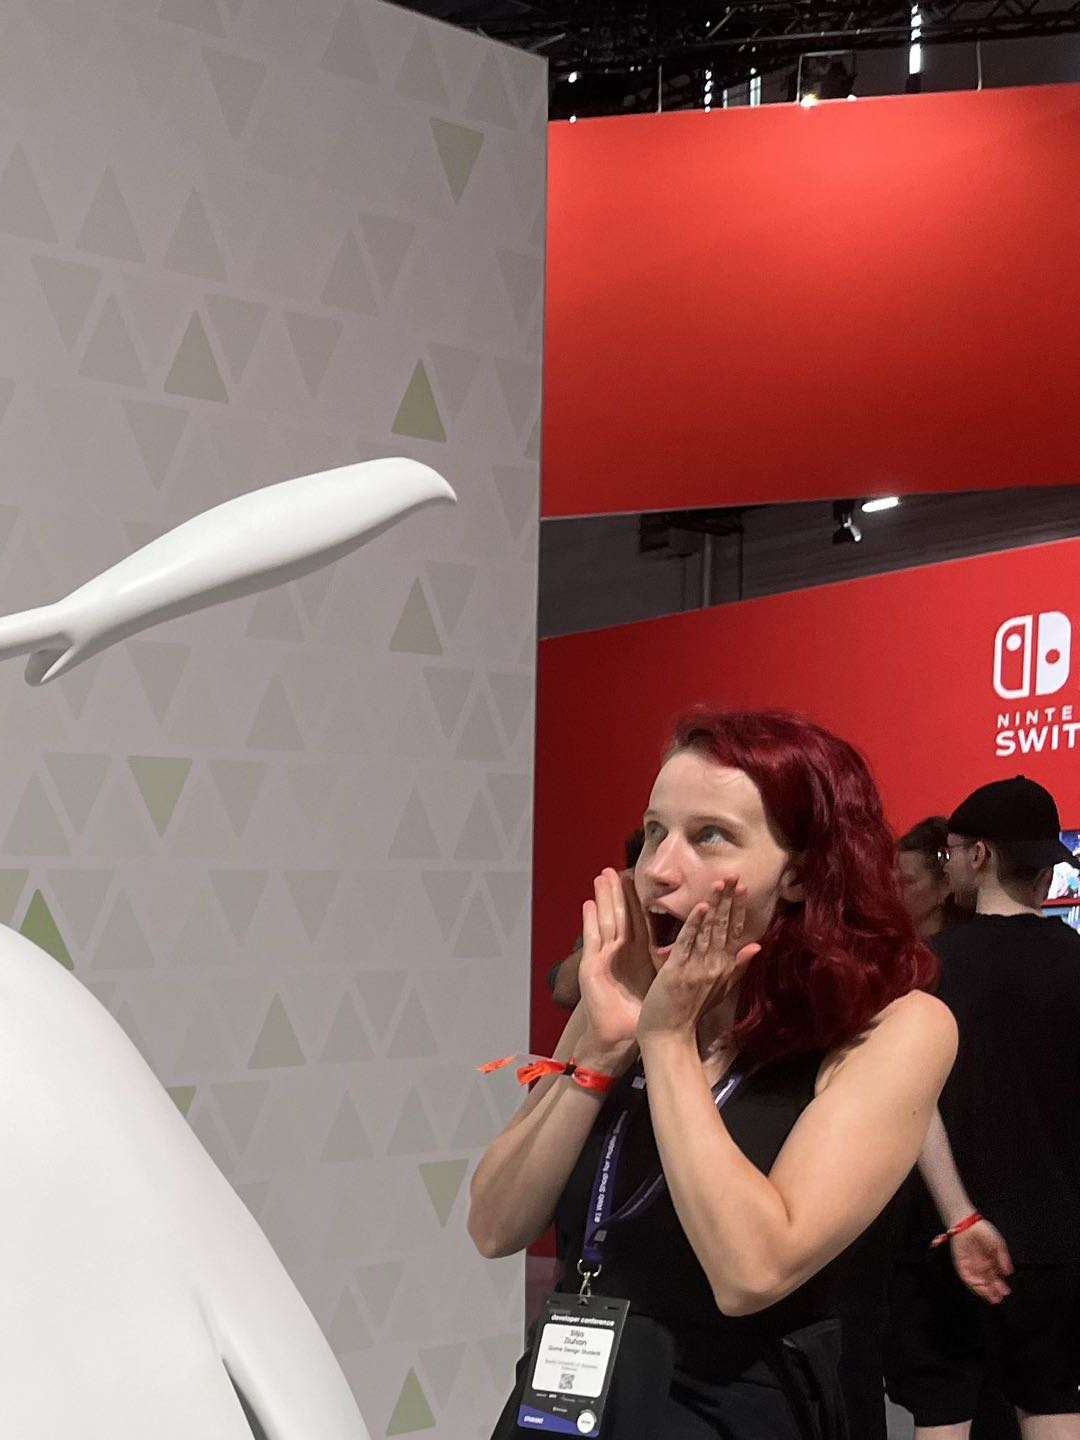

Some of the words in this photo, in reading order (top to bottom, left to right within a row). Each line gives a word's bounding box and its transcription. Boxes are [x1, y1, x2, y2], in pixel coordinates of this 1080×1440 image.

[996, 704, 1073, 729] NINTE
[995, 722, 1080, 757] SWIT
[551, 1314, 580, 1323] developer
[580, 1317, 615, 1327] conference
